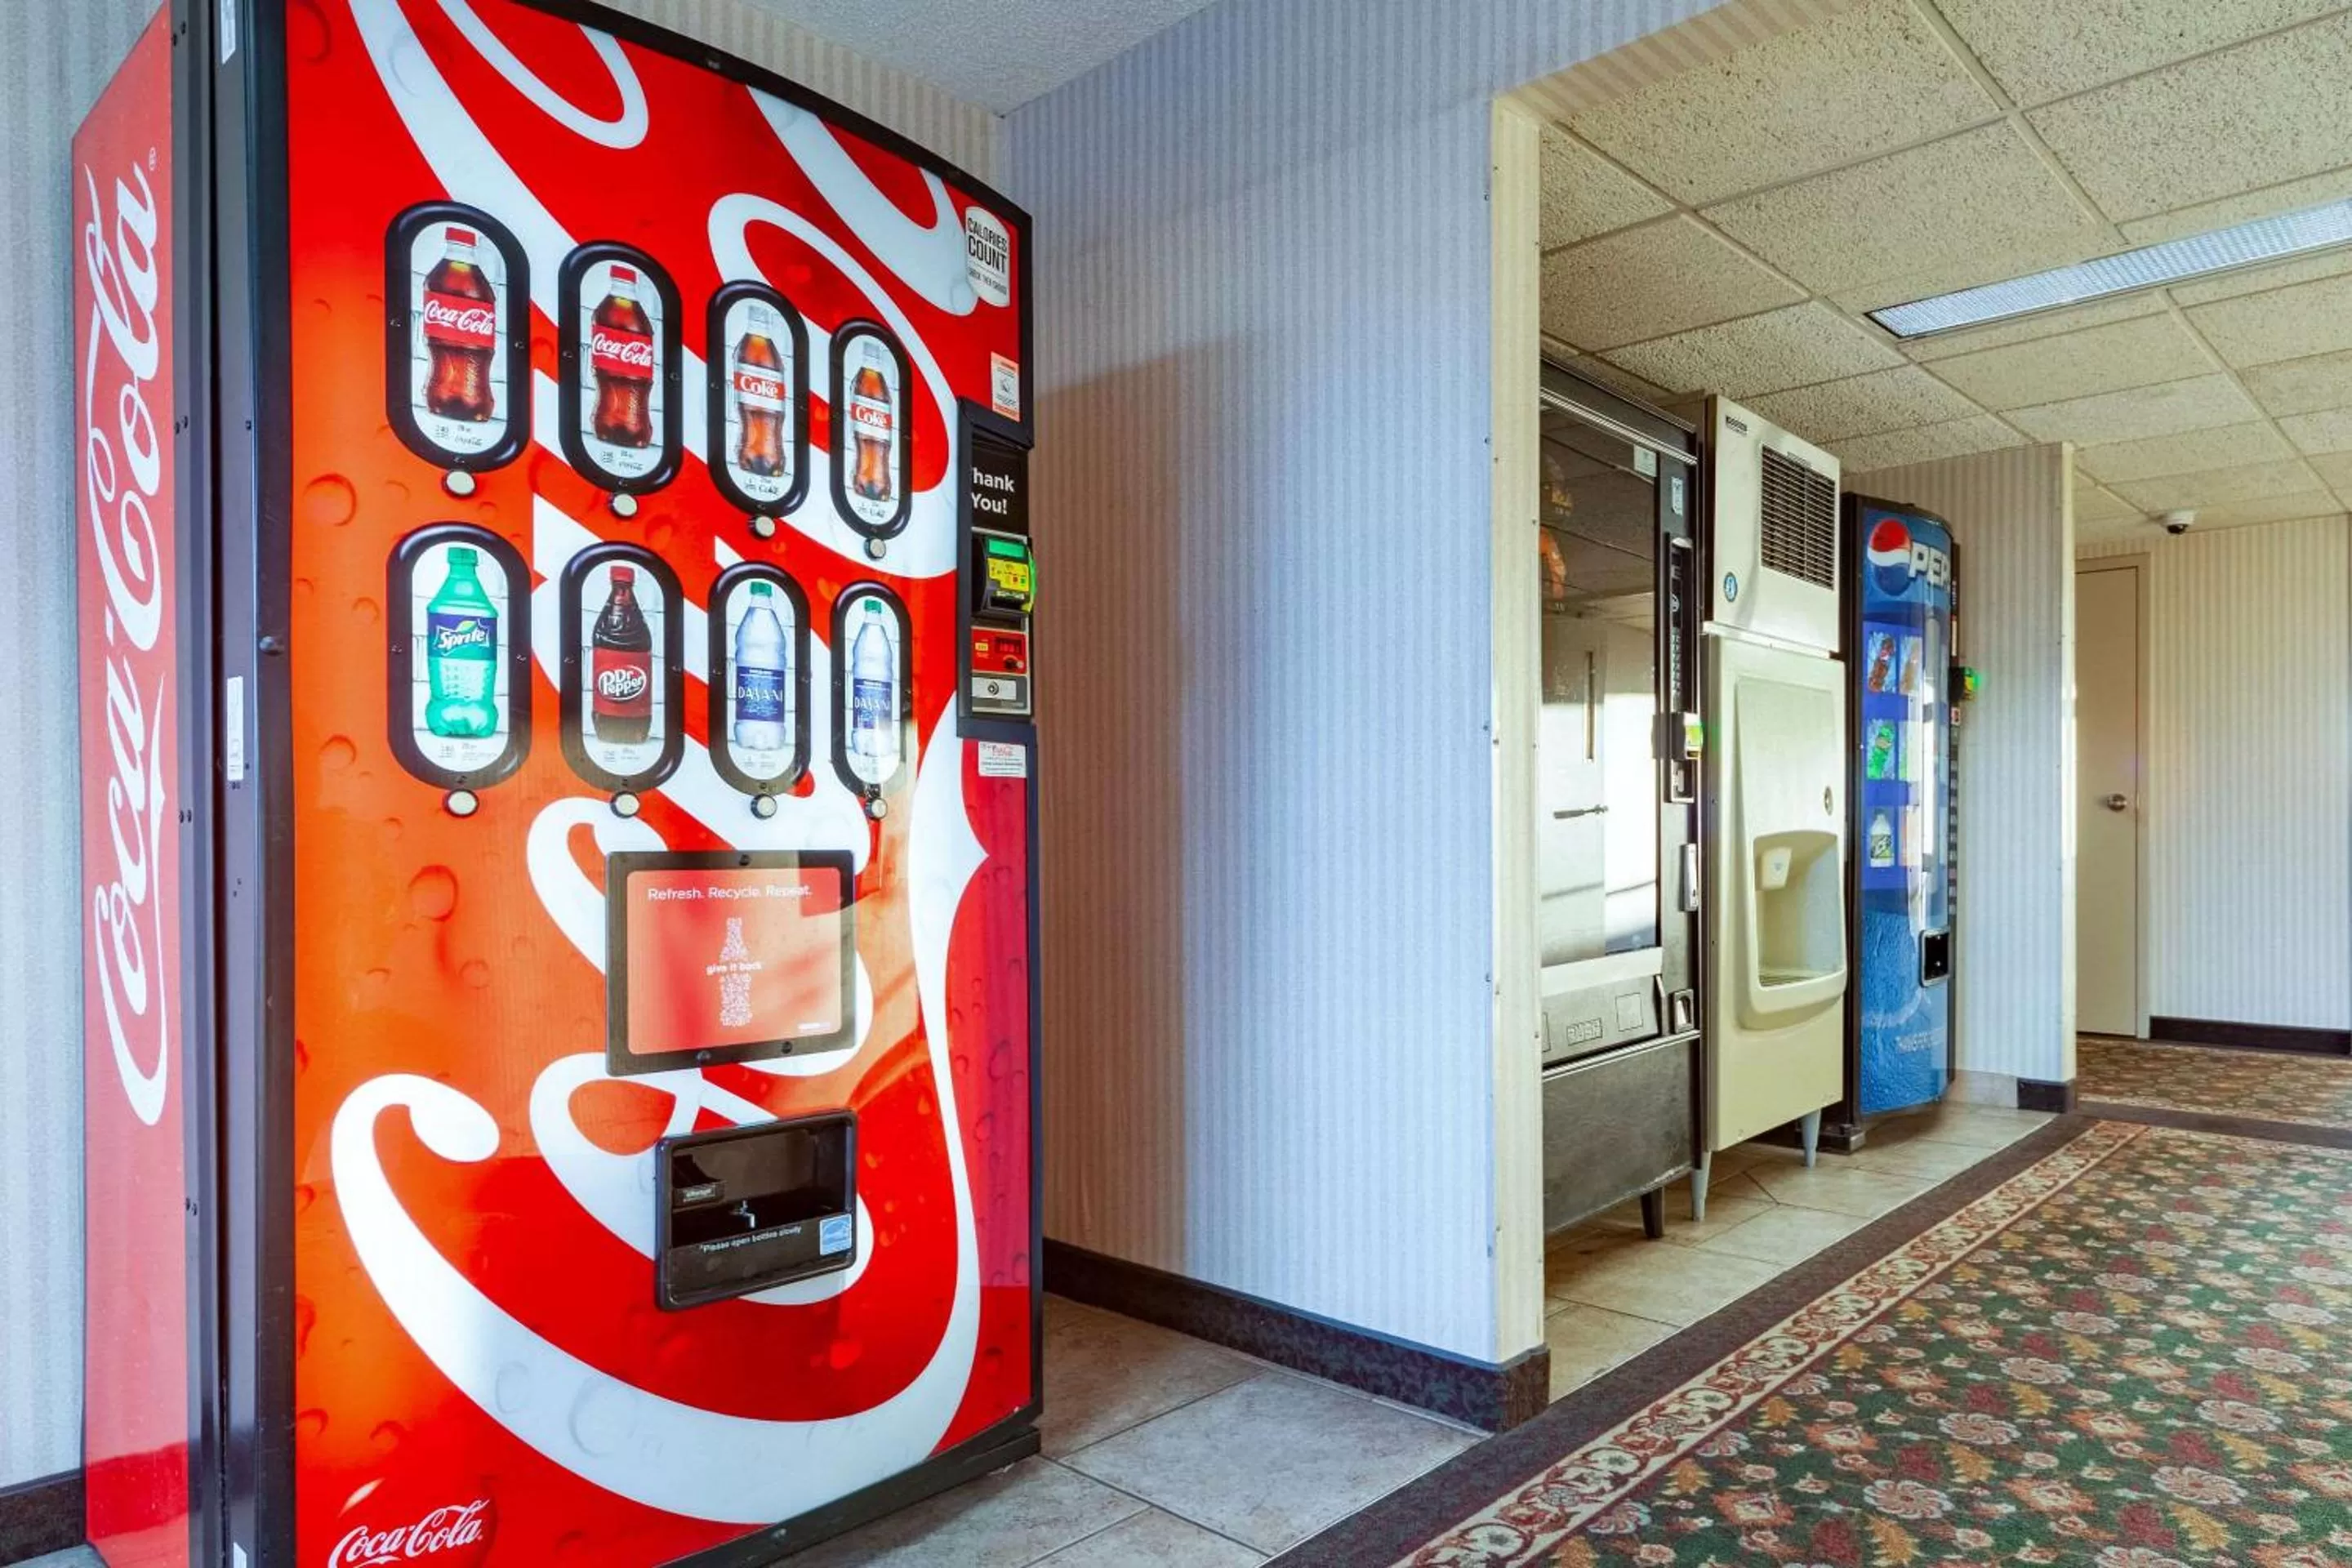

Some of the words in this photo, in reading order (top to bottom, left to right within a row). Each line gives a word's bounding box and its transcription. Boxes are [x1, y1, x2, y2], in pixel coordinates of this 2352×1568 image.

[968, 216, 1008, 254] CALORIES
[969, 234, 1007, 274] COUNT
[423, 299, 494, 336] Coca-Cola
[591, 332, 653, 368] Coca-Cola
[740, 375, 779, 399] Coke
[856, 405, 887, 428] Coke
[970, 466, 1015, 492] hank
[970, 492, 1008, 515] You!
[80, 160, 165, 1127] Coca-Cola
[438, 627, 486, 651] Sprite
[599, 670, 644, 697] Pepper
[614, 669, 635, 684] Dr
[648, 887, 706, 901] Refresh.
[328, 1498, 490, 1568] Coca-Cola
